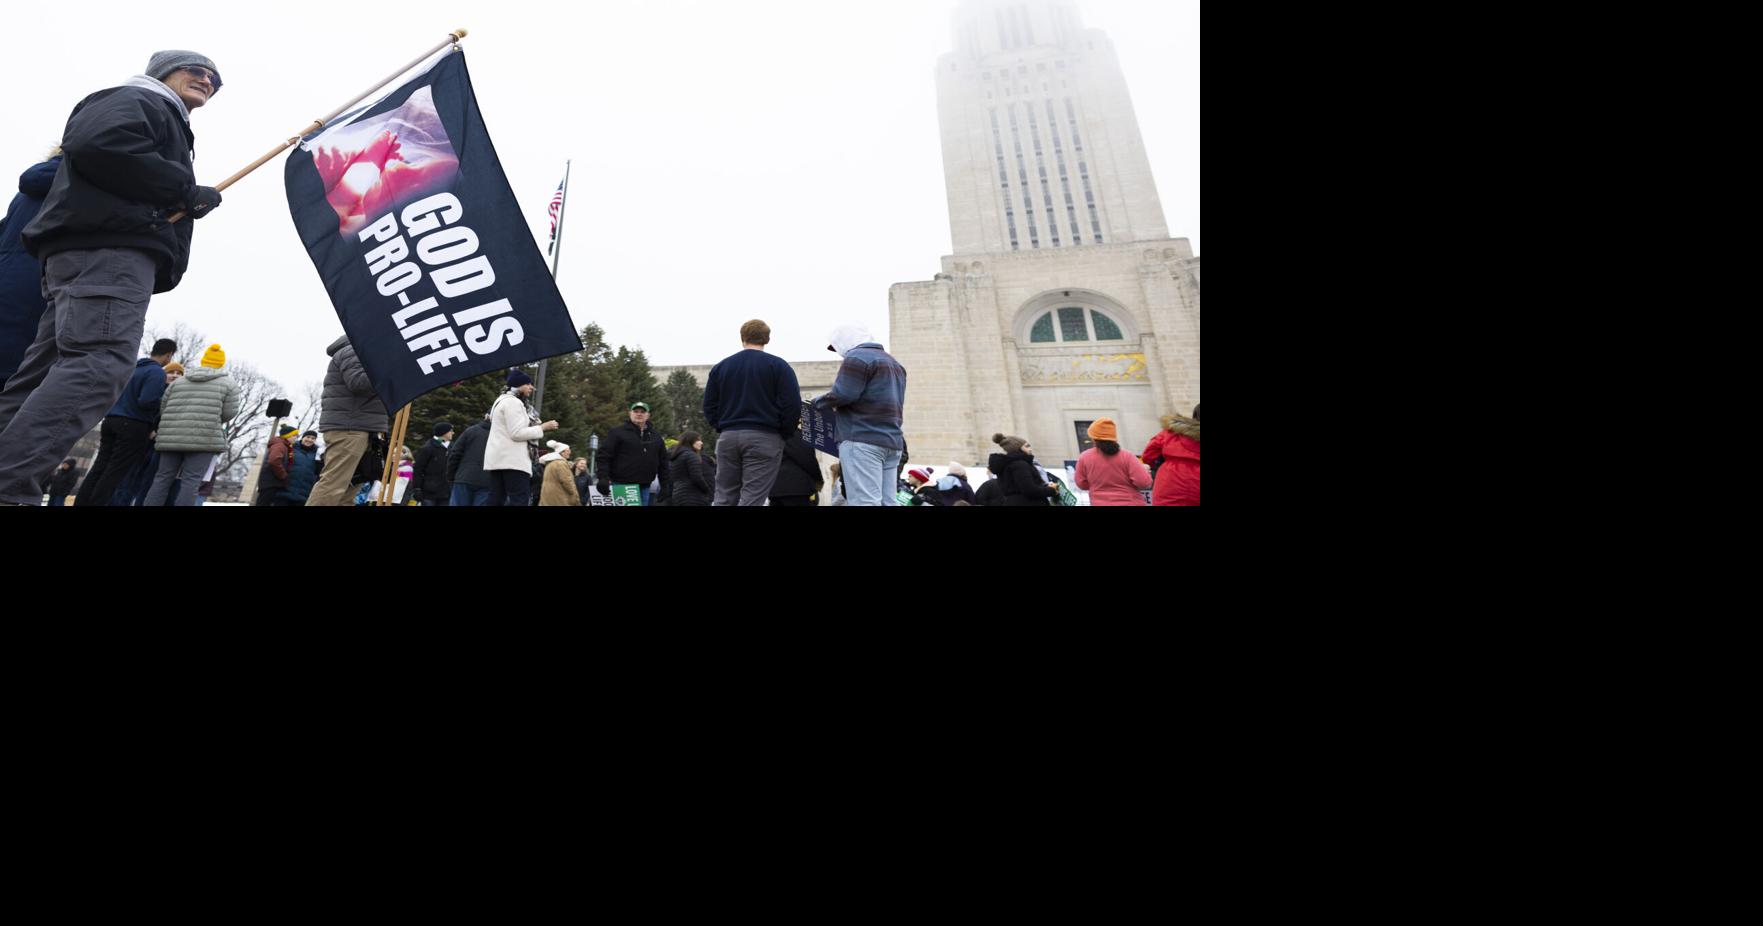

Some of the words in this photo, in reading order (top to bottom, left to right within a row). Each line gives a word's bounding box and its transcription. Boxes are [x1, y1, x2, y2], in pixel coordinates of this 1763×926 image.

[358, 212, 469, 375] PRO-LIFE
[401, 192, 495, 298] GOD
[452, 298, 525, 355] IS
[625, 485, 639, 502] LOVE
